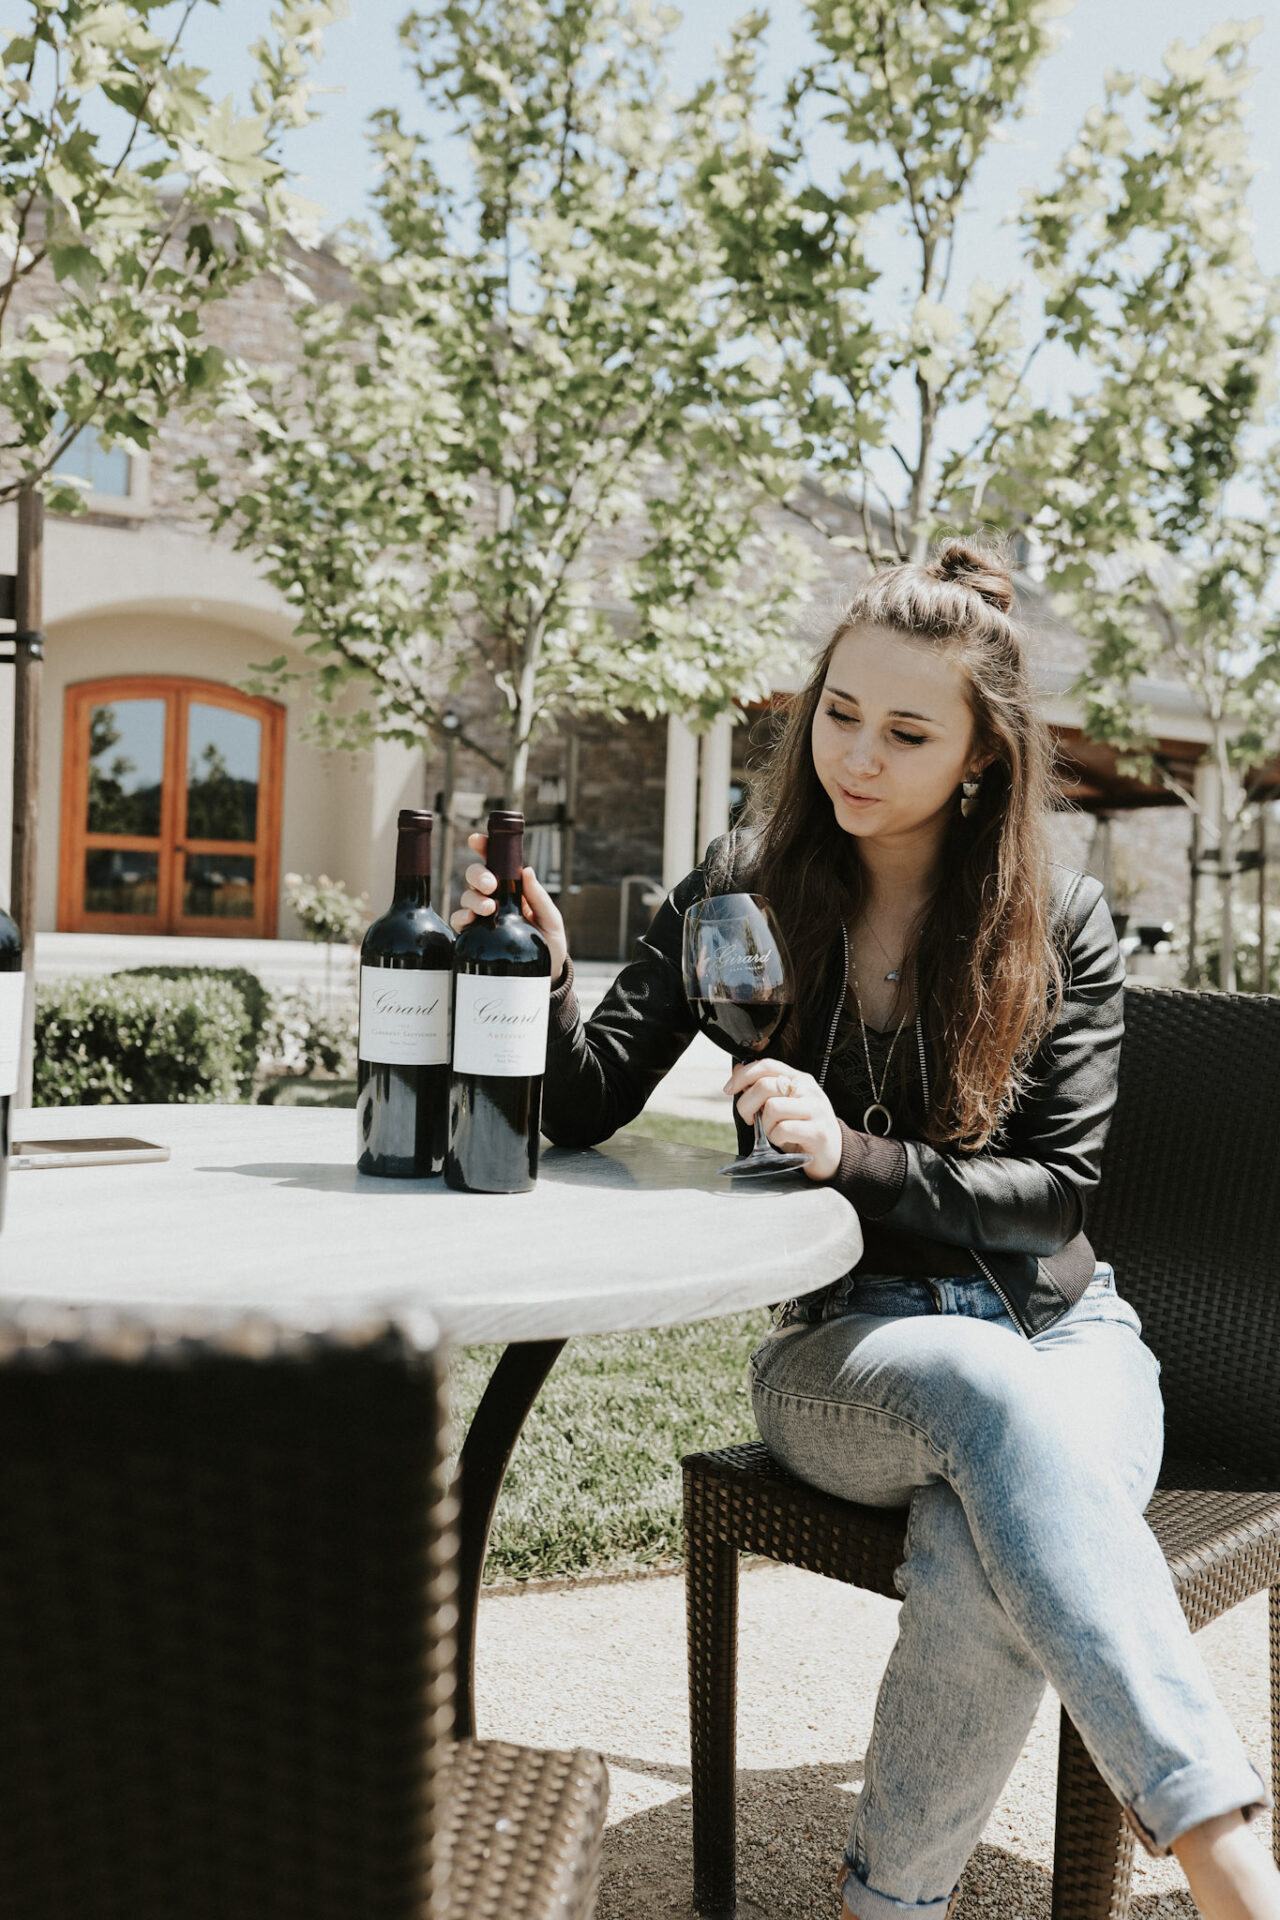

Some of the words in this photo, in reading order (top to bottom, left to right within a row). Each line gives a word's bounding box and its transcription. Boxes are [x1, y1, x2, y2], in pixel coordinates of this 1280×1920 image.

[714, 944, 772, 969] Girard
[372, 988, 439, 1015] Girard
[473, 997, 541, 1025] Girard
